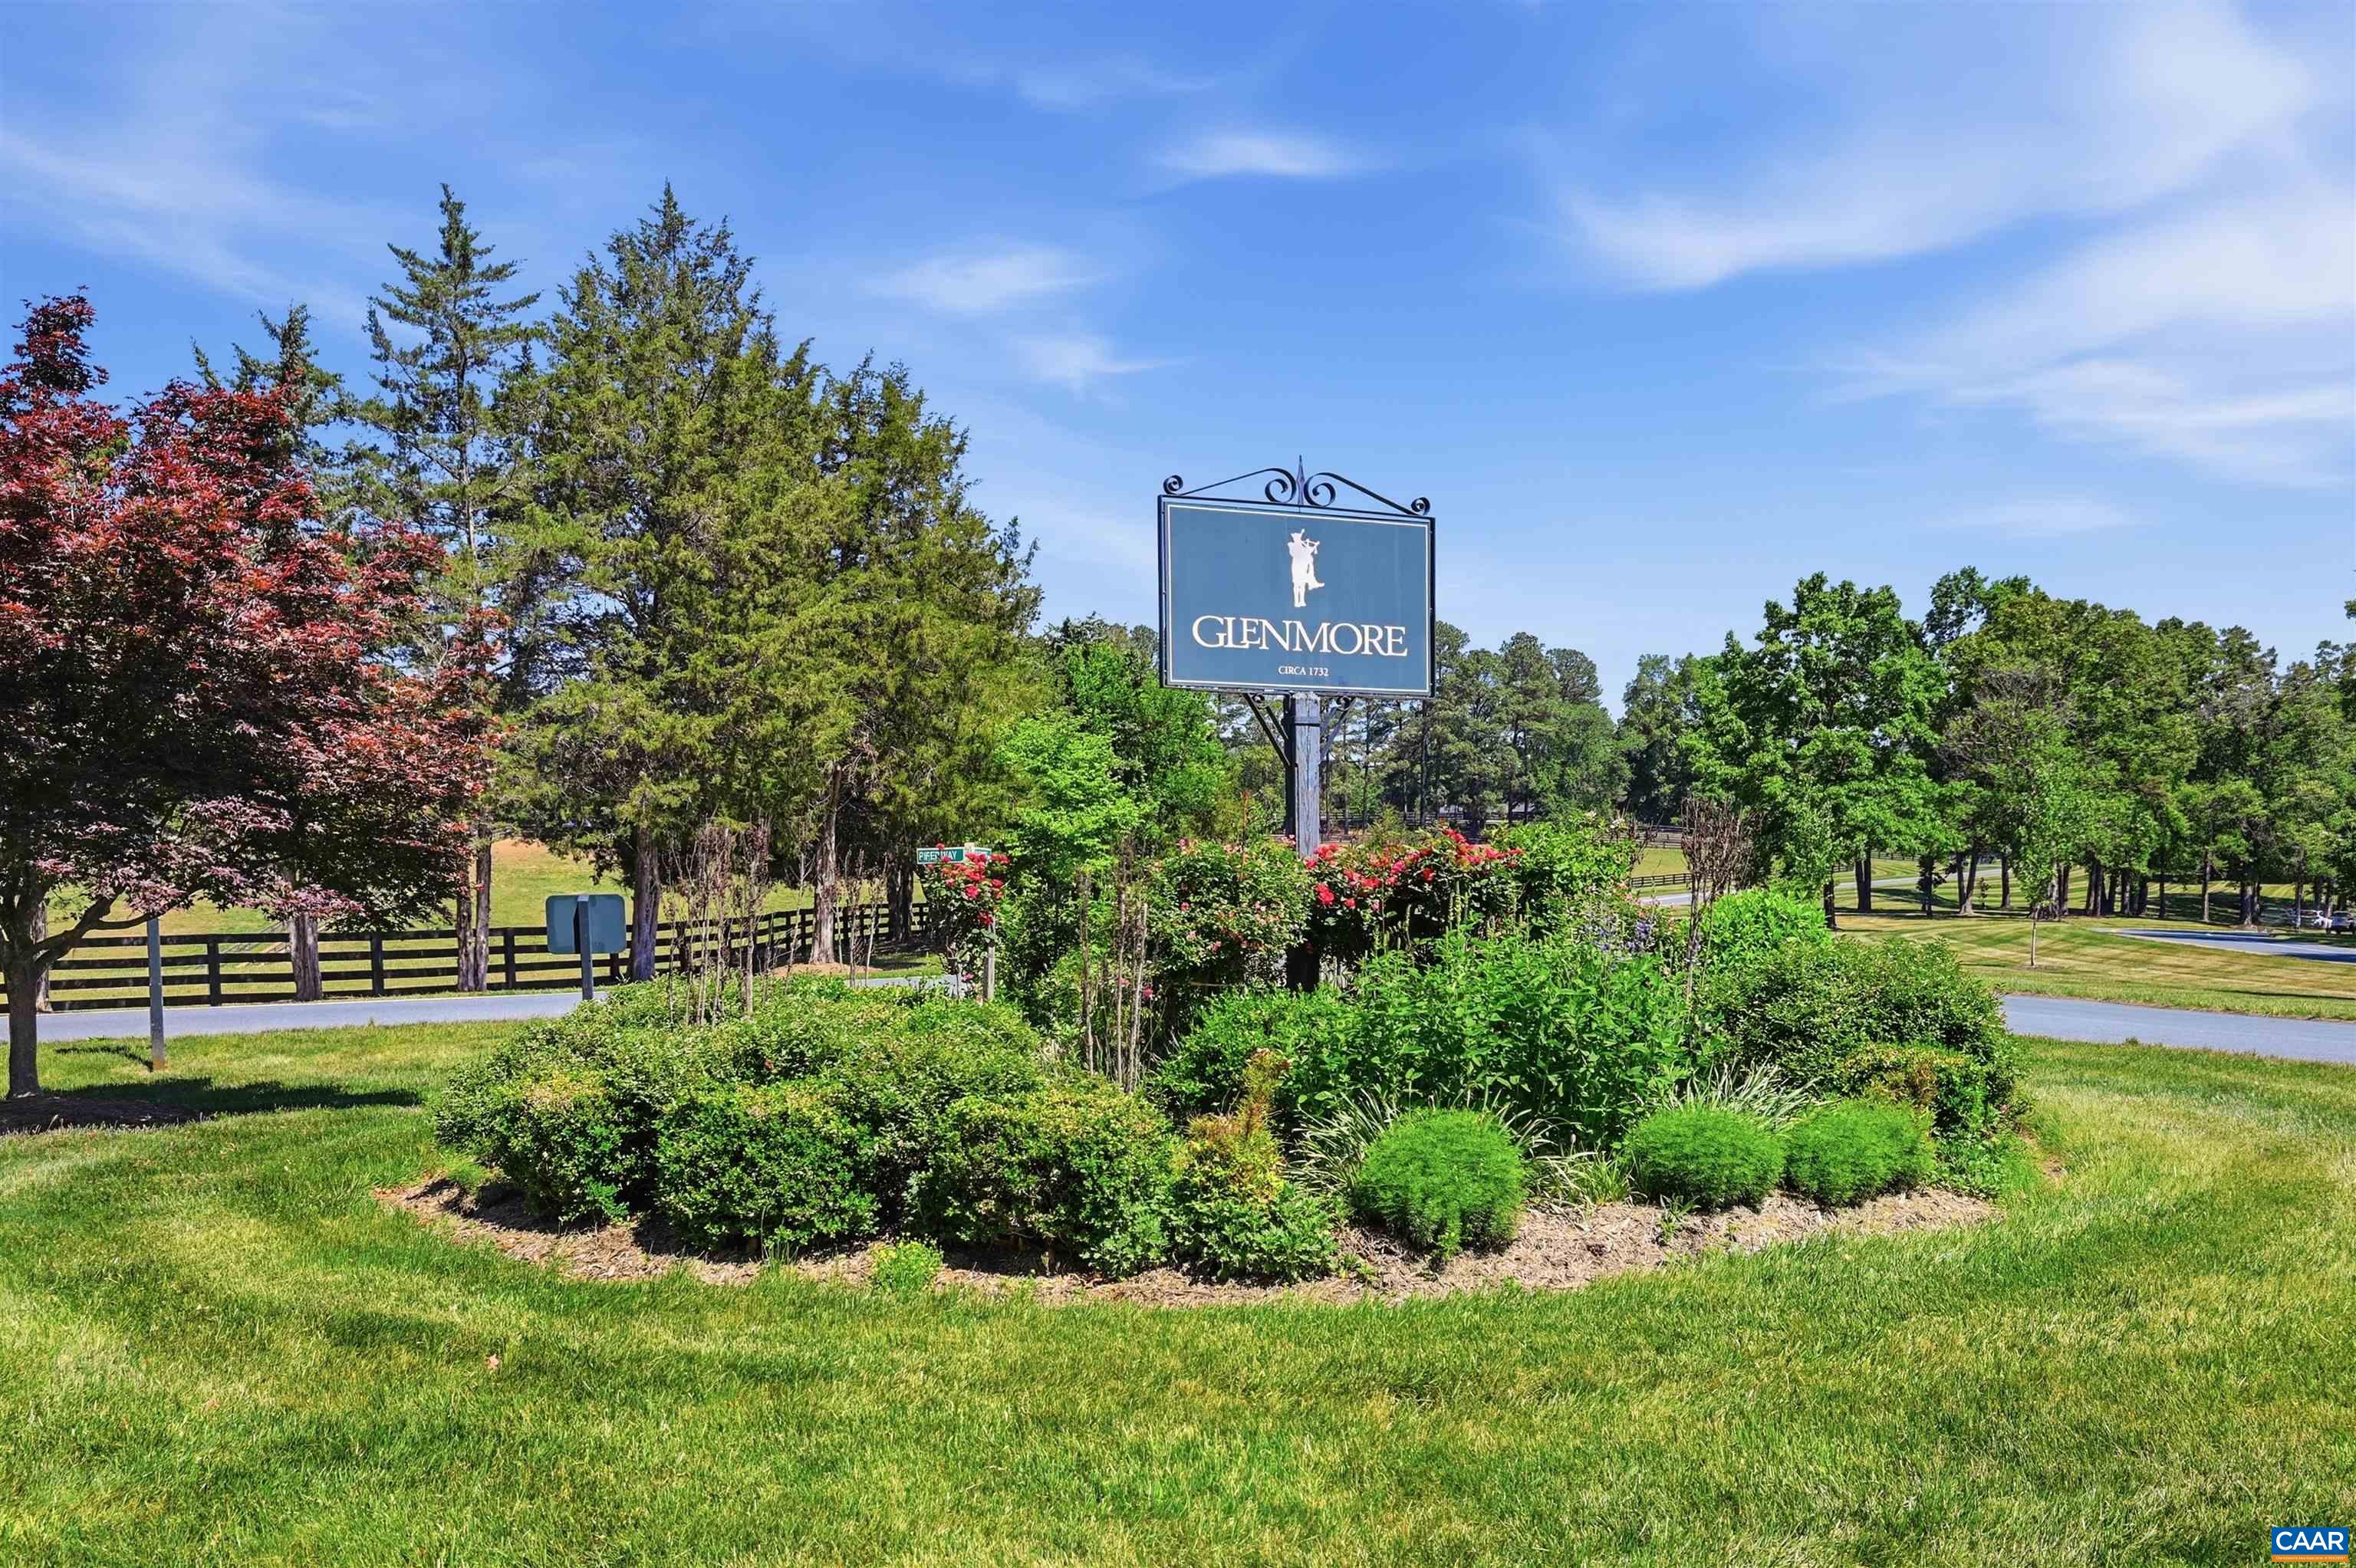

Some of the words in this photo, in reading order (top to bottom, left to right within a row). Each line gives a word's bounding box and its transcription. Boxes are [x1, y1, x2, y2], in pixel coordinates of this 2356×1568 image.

[1191, 615, 1408, 657] GLENMORE
[1278, 666, 1307, 676] CIRCA
[1309, 666, 1330, 676] 1732
